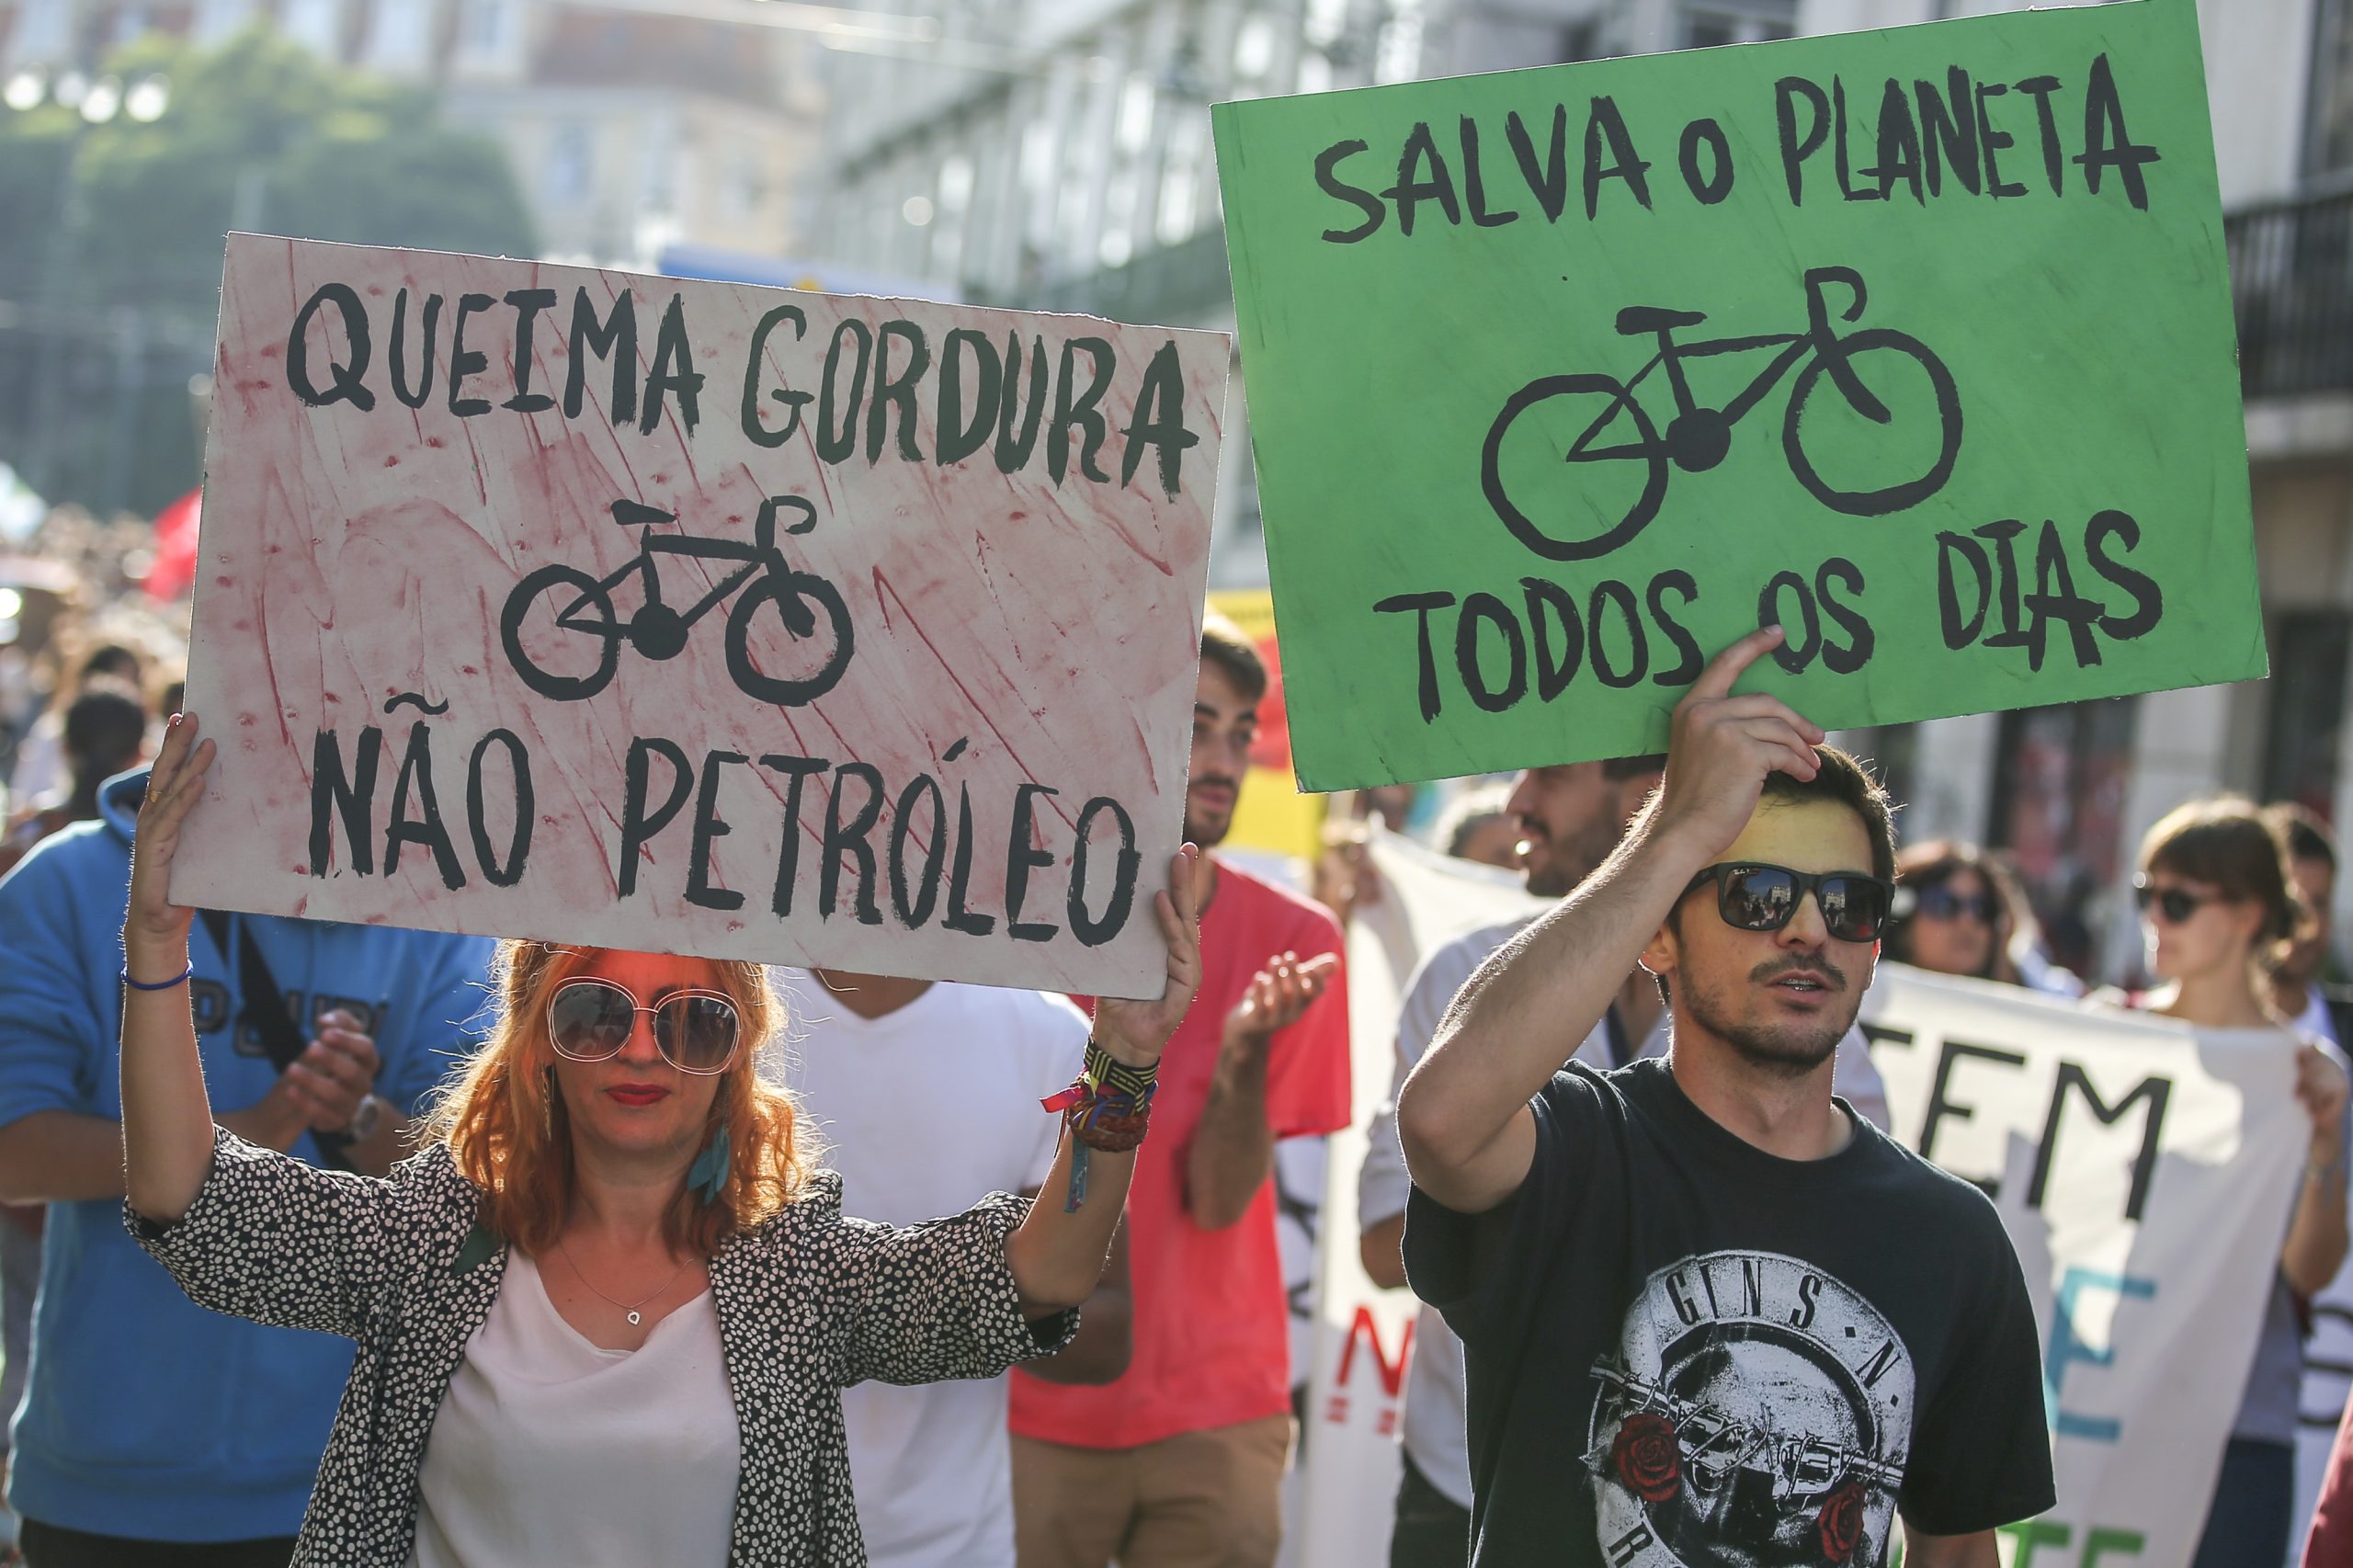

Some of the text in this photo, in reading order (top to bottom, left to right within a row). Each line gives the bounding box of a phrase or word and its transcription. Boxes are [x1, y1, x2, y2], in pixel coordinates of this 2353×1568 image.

[1314, 52, 2162, 244] SALVA O PLANETA
[286, 282, 1199, 504] QUEIMA GORDURA
[1373, 508, 2164, 724] TODOS OS DIAS
[308, 692, 1142, 948] NÃO PETRÓLEO
